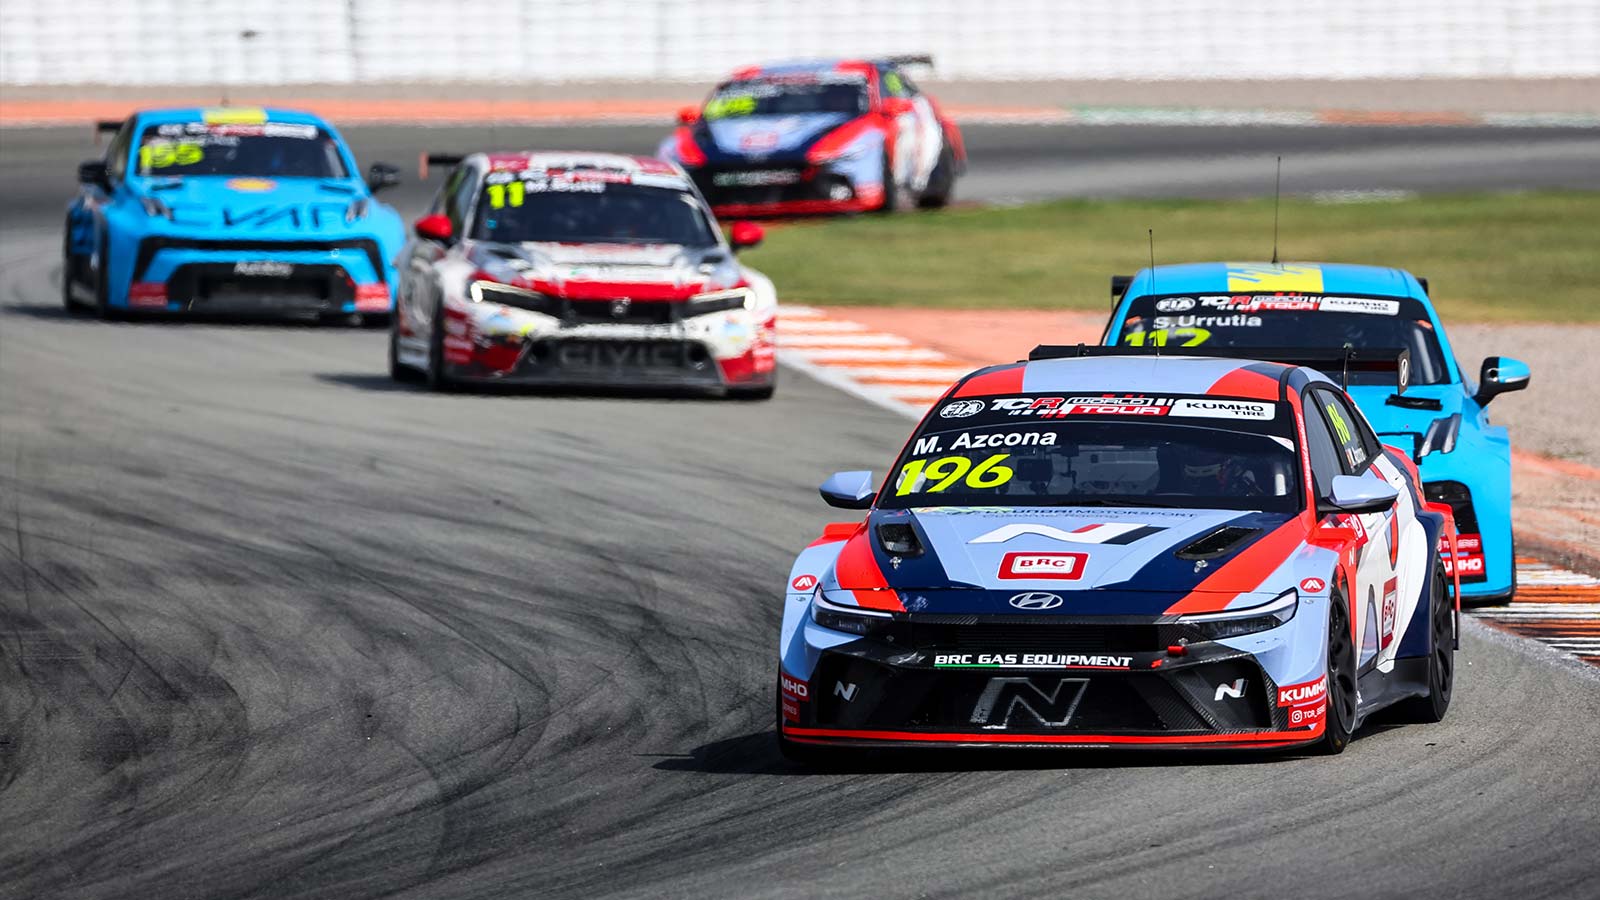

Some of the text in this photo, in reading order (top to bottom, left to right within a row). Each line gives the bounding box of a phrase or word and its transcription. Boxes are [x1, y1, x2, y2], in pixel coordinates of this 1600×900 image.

[487, 181, 525, 209] 11
[1199, 296, 1251, 308] TCR
[1262, 302, 1315, 310] TOUR
[942, 397, 1264, 418] FIA TCR WORLD KUMHO
[1079, 405, 1162, 415] TOUR
[912, 432, 1058, 456] M. Azcona
[896, 454, 1014, 497] 196
[1020, 558, 1067, 568] BRC
[934, 654, 1133, 667] BRC GAS EQUIPMENT
